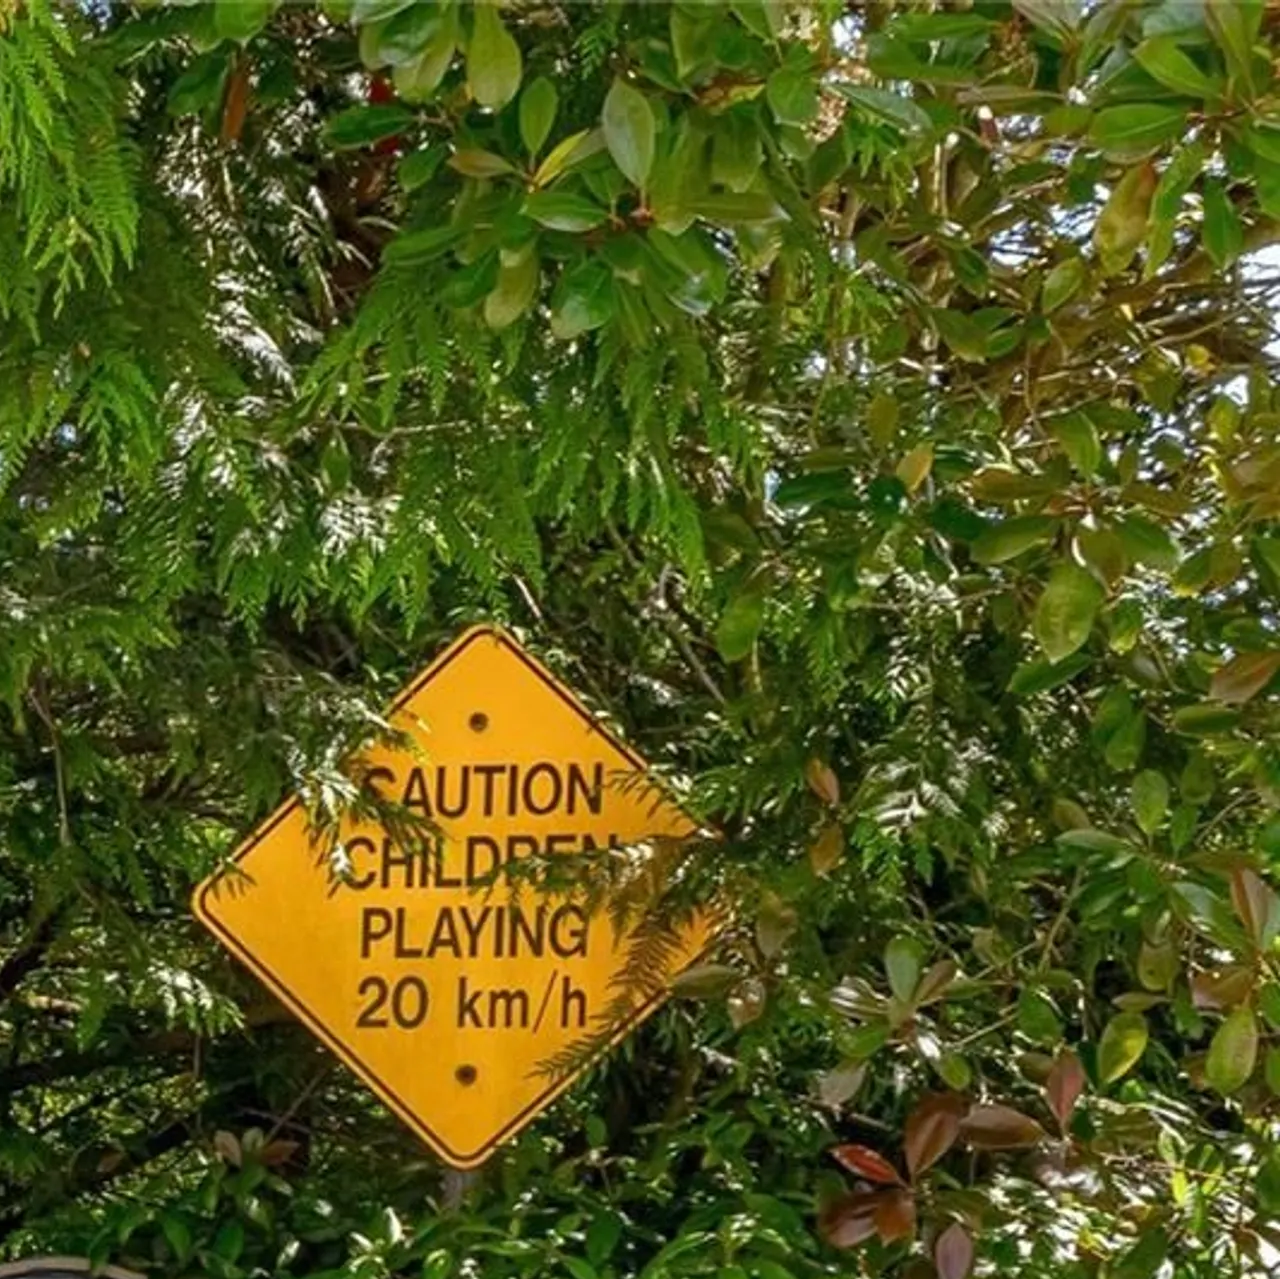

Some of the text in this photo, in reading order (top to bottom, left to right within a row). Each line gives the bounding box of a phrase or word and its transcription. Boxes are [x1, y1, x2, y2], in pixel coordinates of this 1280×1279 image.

[359, 903, 589, 959] PLAYING
[354, 969, 588, 1034] 20 km/h
